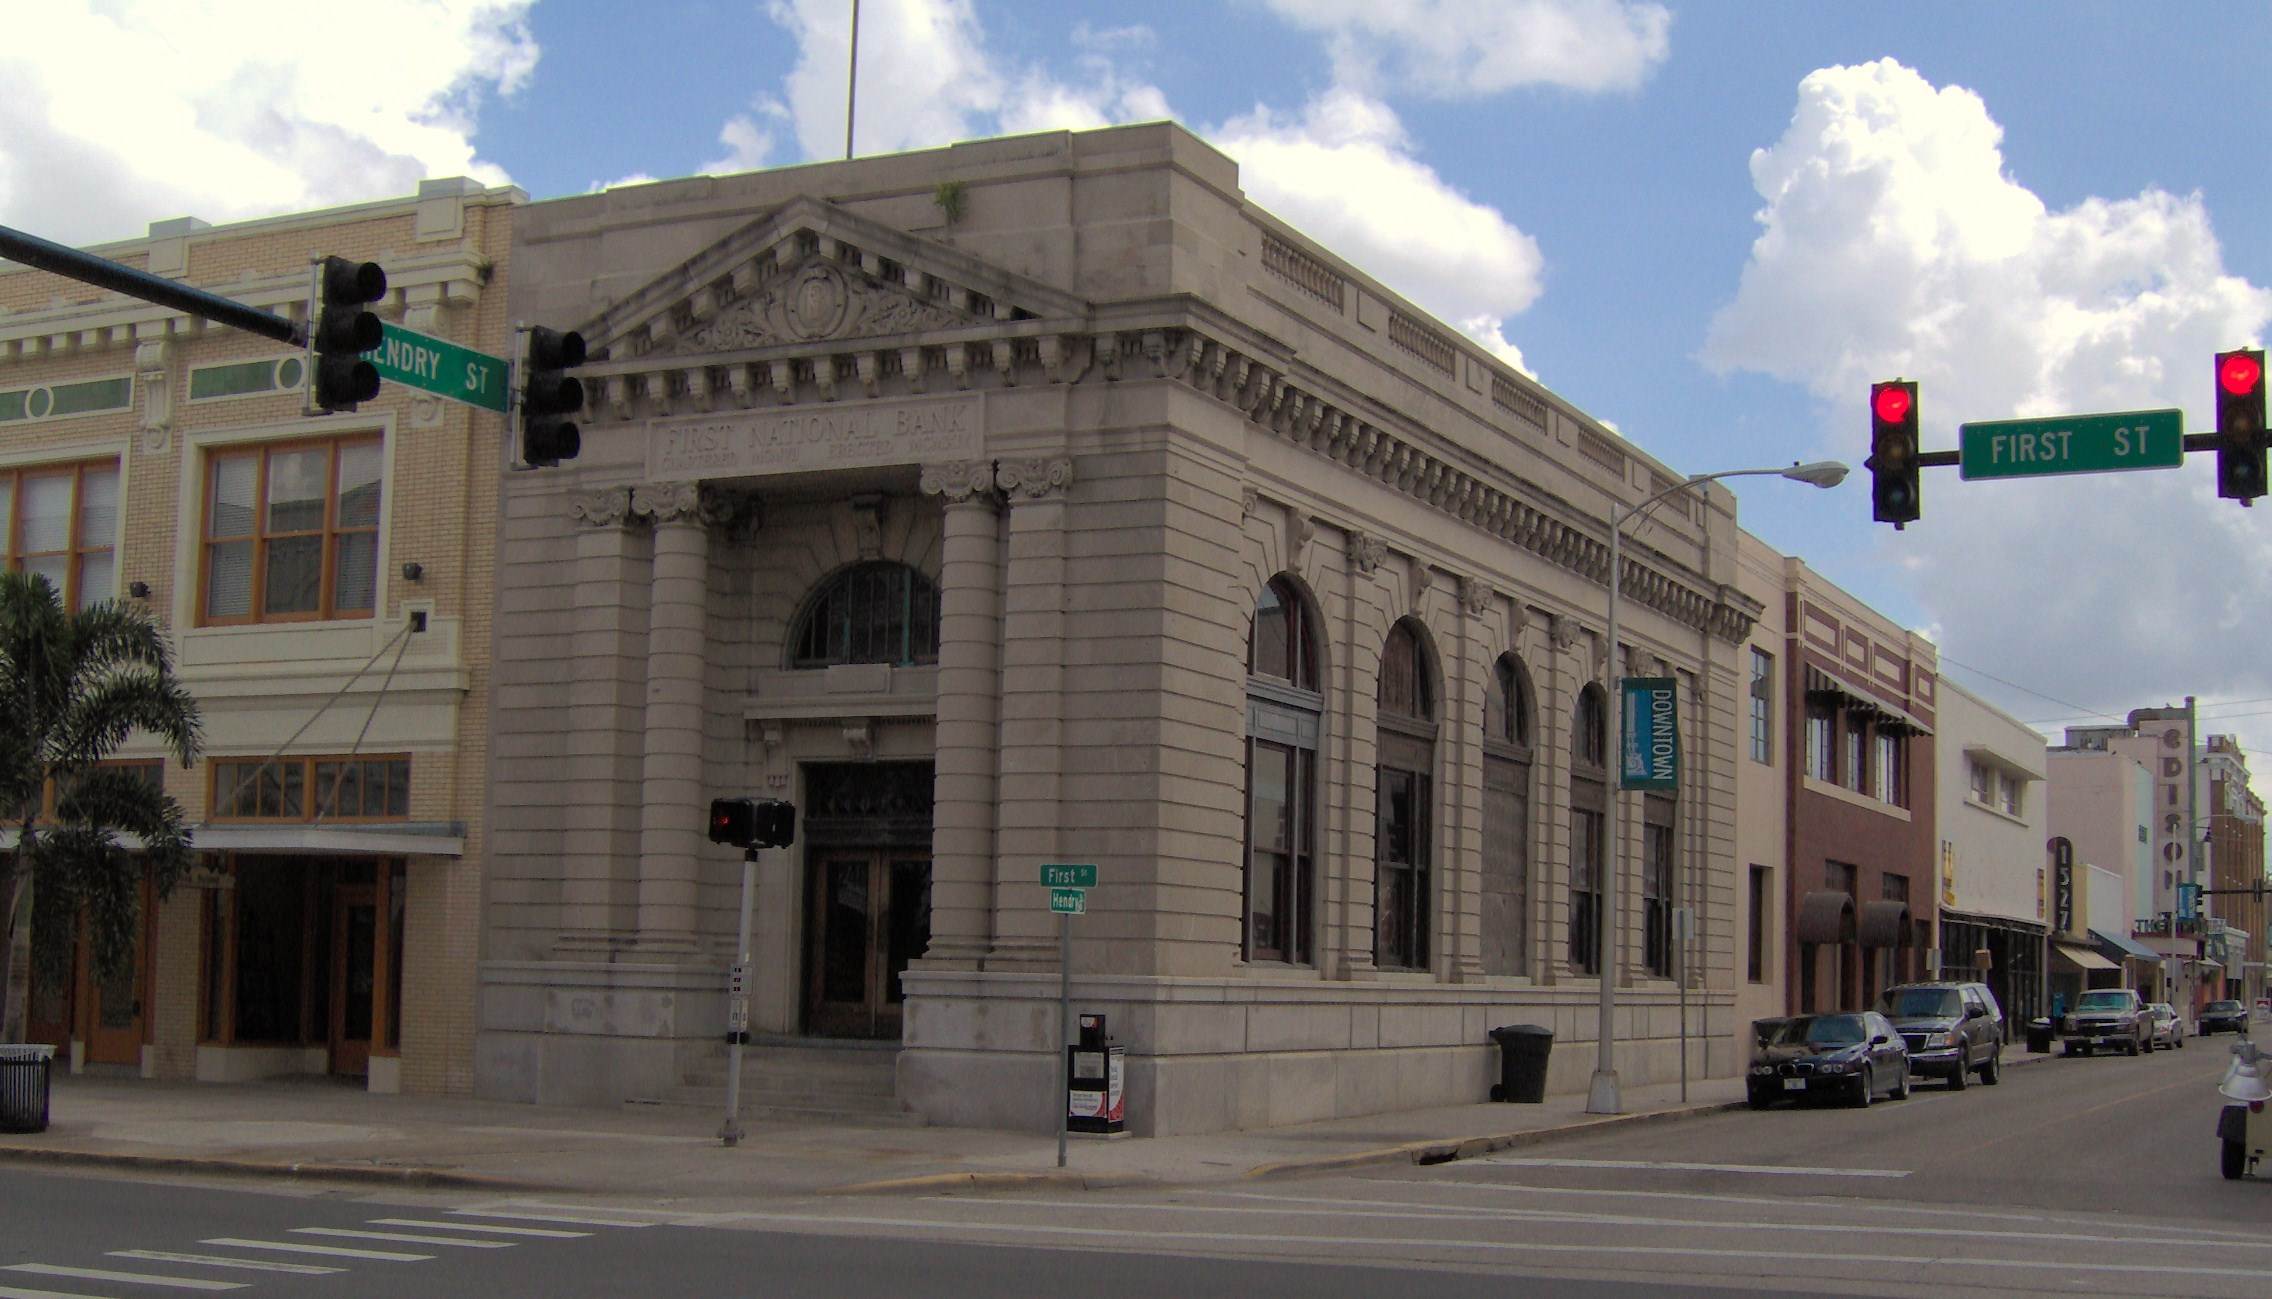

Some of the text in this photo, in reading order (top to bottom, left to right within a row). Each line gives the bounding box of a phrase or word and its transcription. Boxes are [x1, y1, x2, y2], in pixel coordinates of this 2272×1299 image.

[466, 362, 489, 394] ST
[666, 425, 735, 454] FIRST
[749, 412, 878, 448] NATIONAL
[893, 404, 968, 437] BANK
[1992, 426, 2150, 464] FIRST ST
[1652, 689, 1673, 780] DOWNTOWN
[1049, 868, 1075, 883] First
[2060, 844, 2071, 931] 1527
